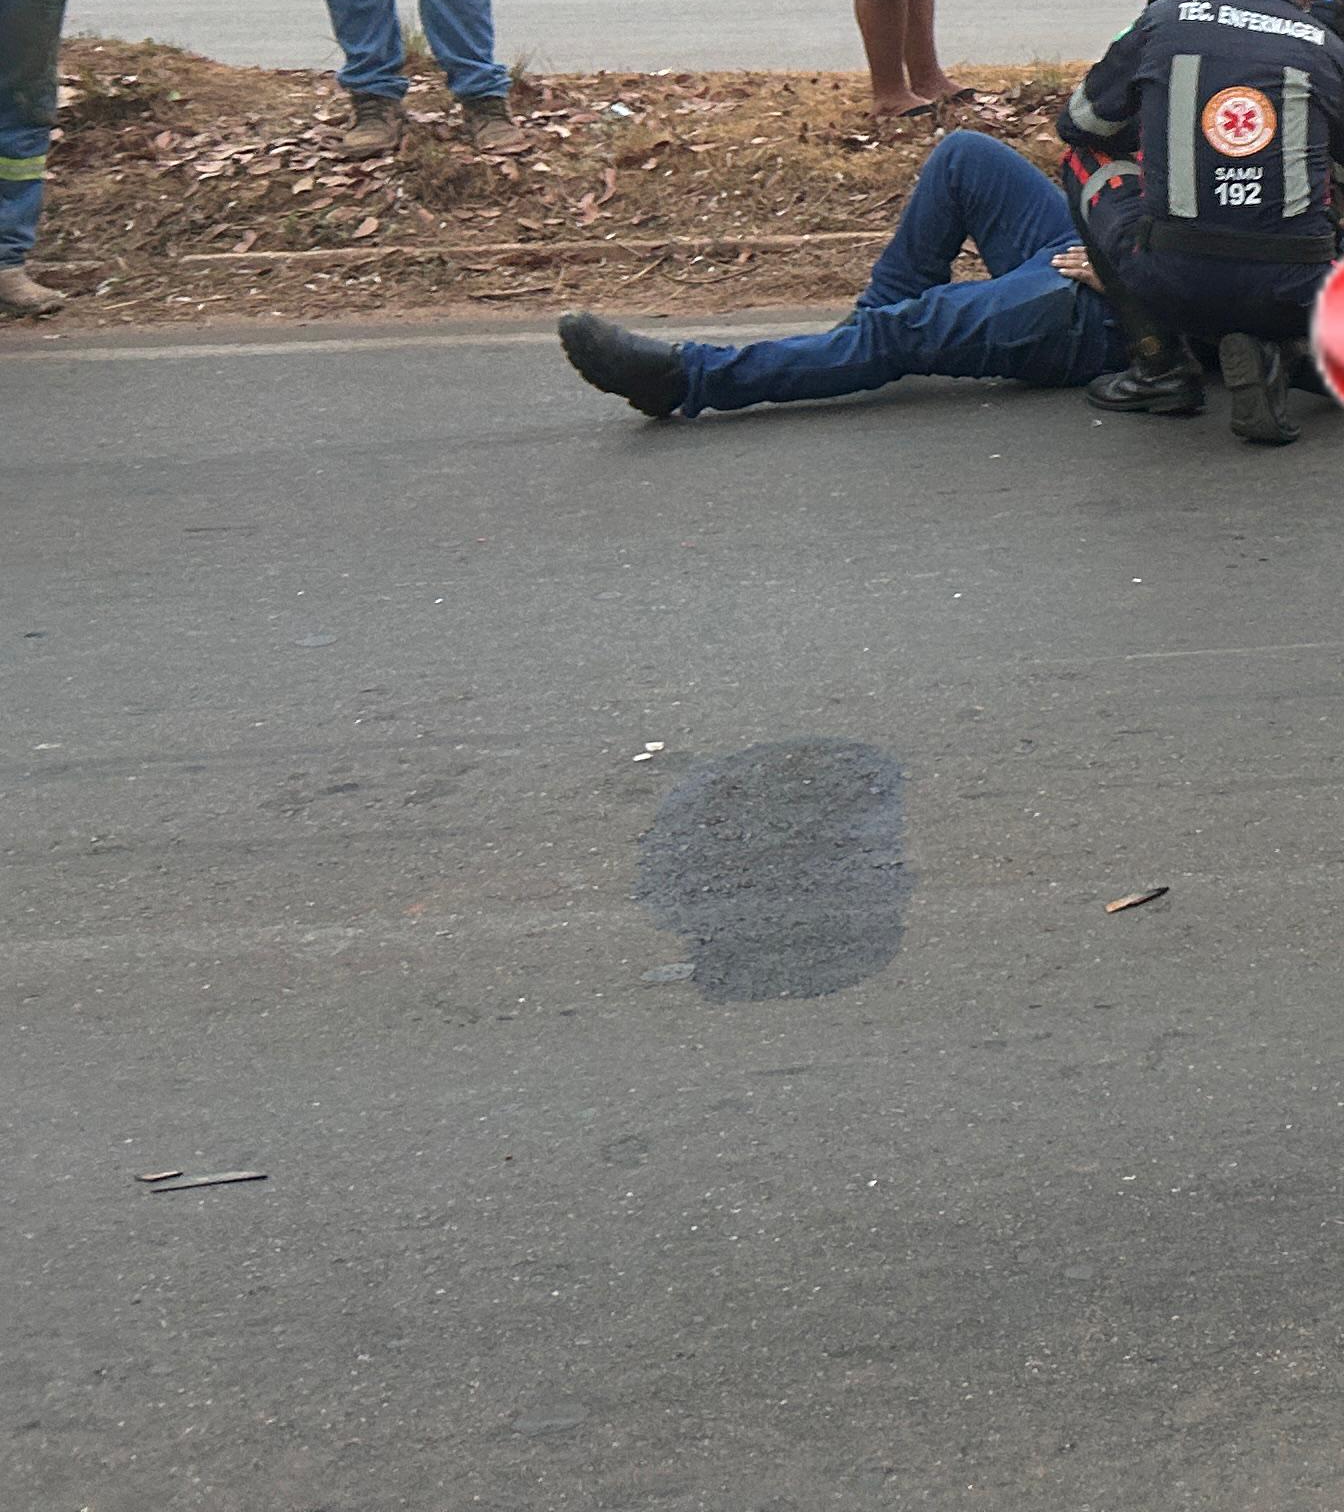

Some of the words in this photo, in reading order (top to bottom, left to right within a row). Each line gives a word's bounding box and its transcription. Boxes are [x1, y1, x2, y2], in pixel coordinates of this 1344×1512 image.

[1217, 5, 1326, 46] ENFERMAGEM
[1214, 166, 1264, 181] SAMU
[1214, 182, 1263, 206] 192
